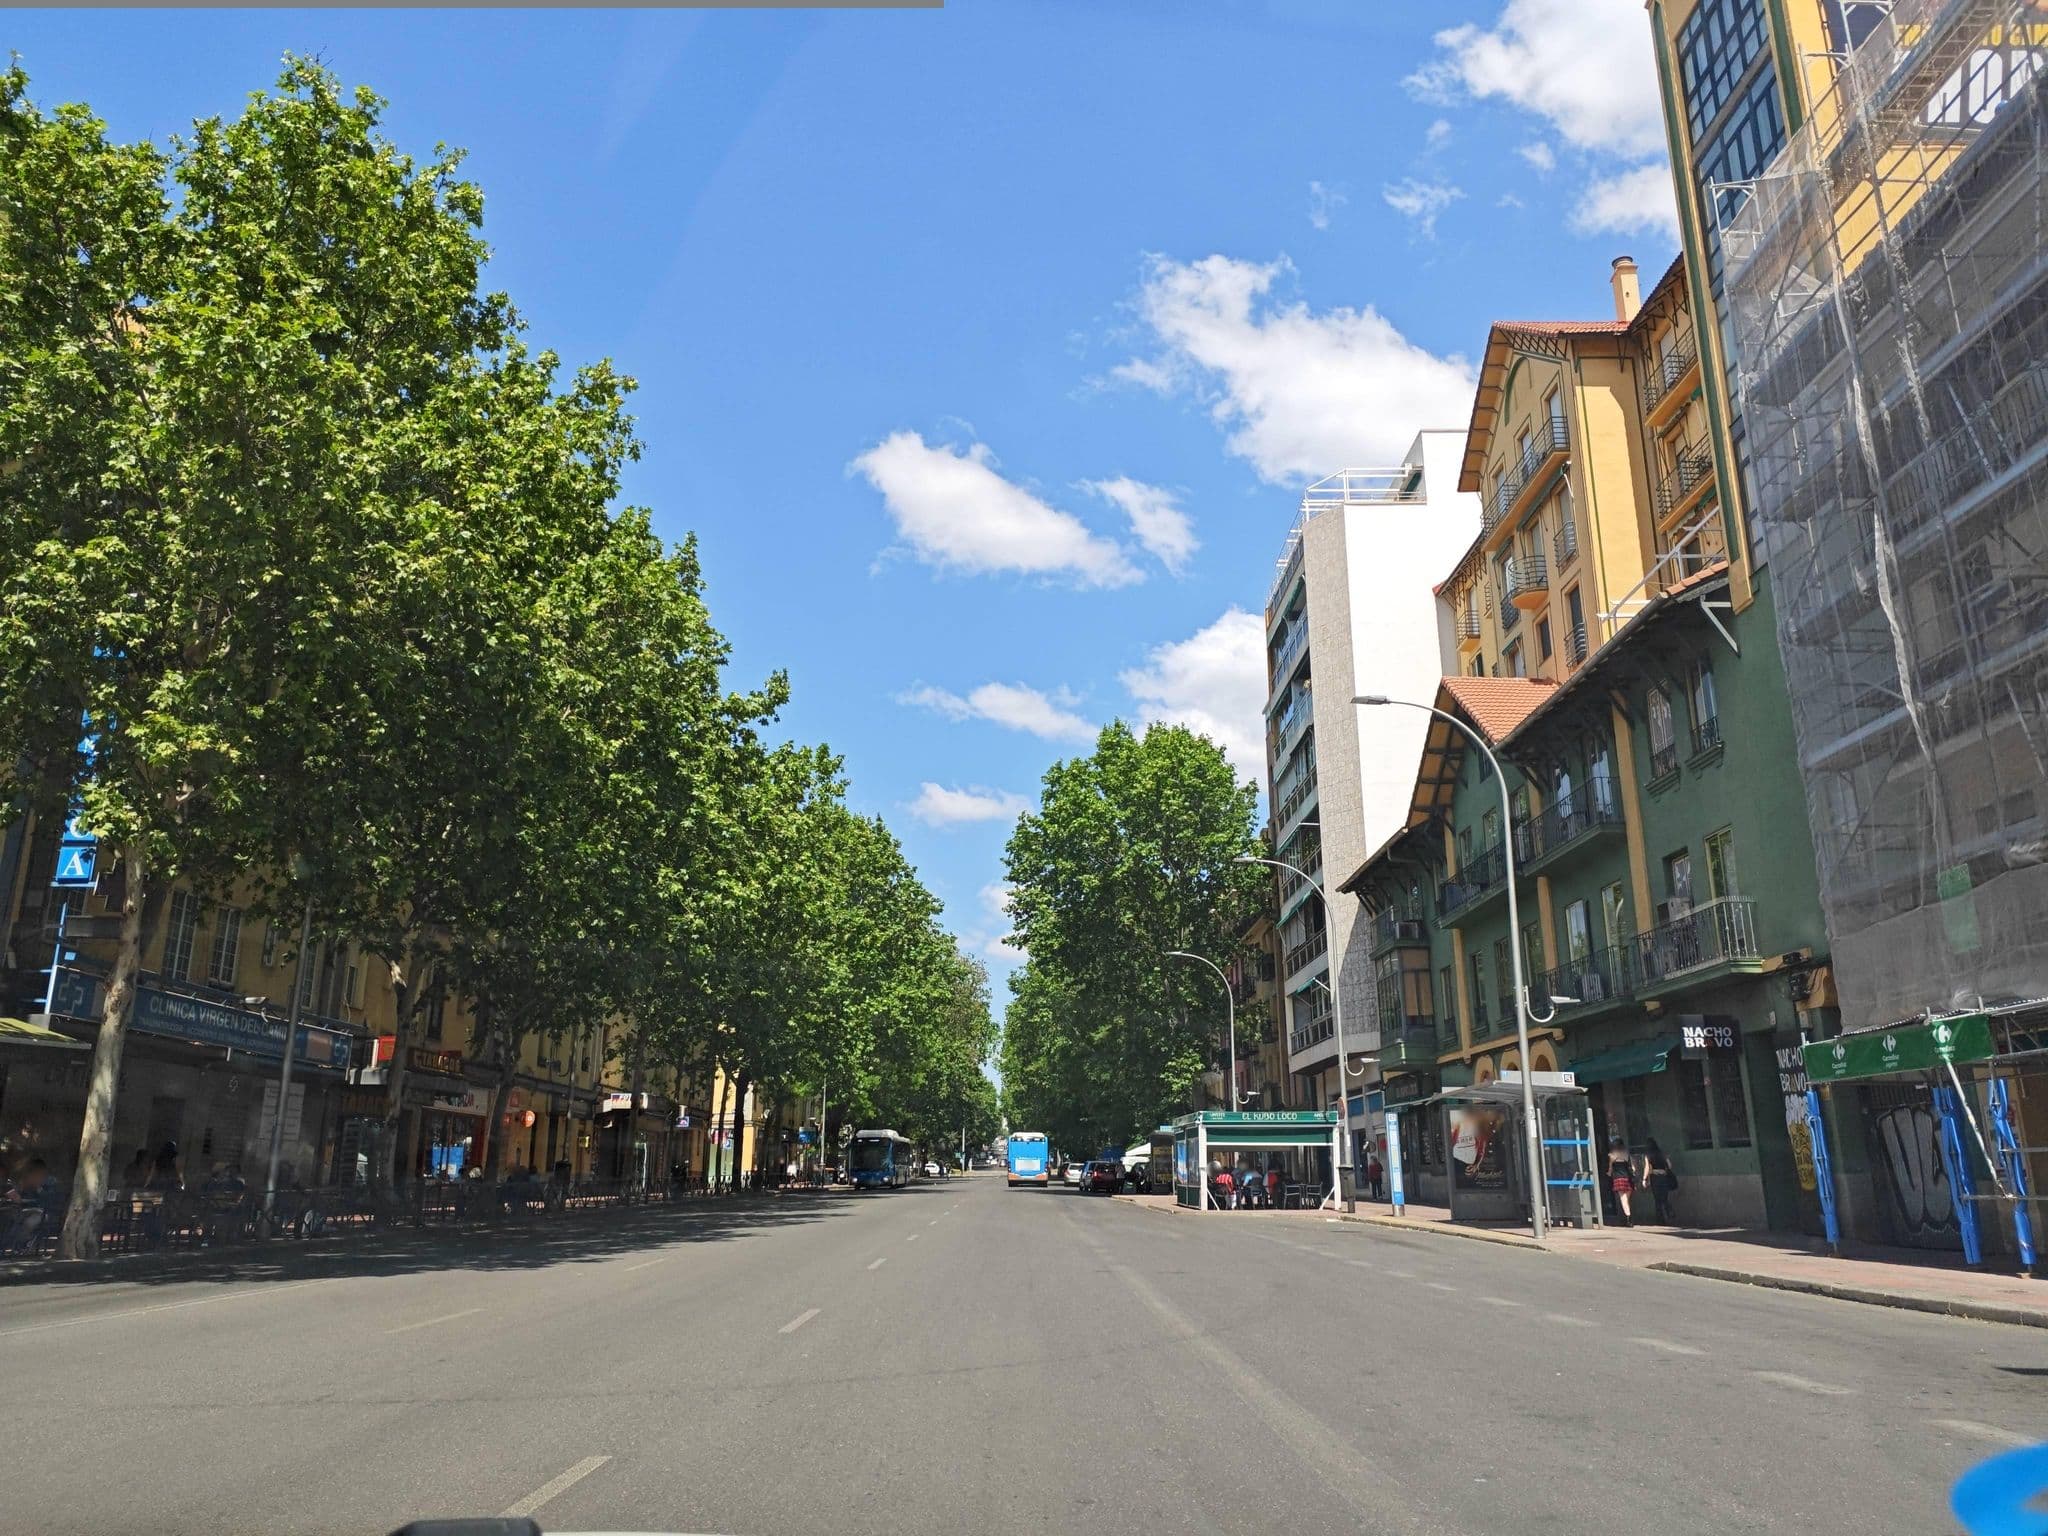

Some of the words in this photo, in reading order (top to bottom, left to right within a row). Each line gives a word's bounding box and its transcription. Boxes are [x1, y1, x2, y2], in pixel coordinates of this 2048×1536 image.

[151, 996, 196, 1021] CLINICA
[200, 1007, 239, 1031] VIRGEN
[240, 1016, 260, 1035] DEL
[1682, 1026, 1732, 1037] NACHO
[1685, 1038, 1733, 1048] BRAVO
[1776, 1046, 1803, 1069] NACHO
[1780, 1072, 1806, 1092] BRAVO
[1242, 1112, 1251, 1120] EL
[1253, 1112, 1275, 1120] KUBO
[1277, 1112, 1297, 1120] LOCO
